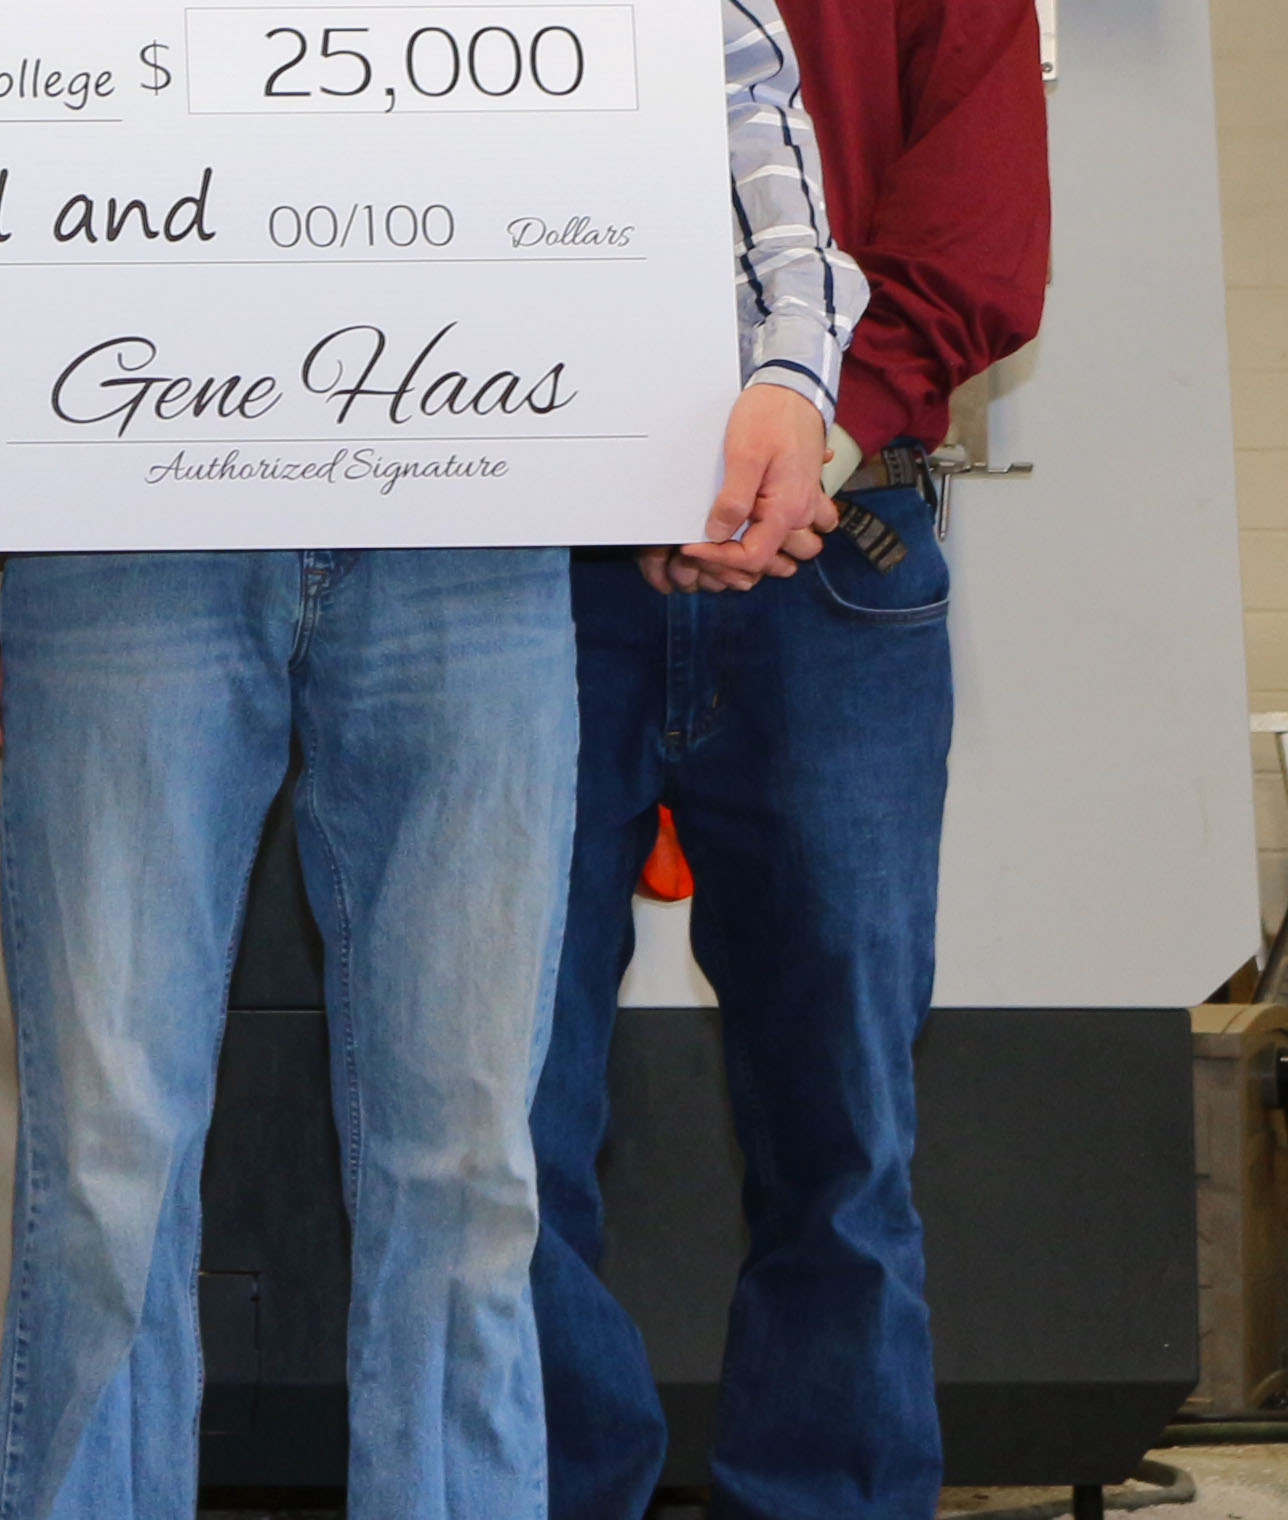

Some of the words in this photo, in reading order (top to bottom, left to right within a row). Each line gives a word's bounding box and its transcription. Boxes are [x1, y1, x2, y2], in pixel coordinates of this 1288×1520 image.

[139, 39, 173, 97] $
[262, 25, 585, 113] 25,000
[52, 166, 217, 245] and
[268, 203, 455, 249] 00/100
[506, 215, 635, 249] Dollars
[50, 335, 284, 438] Gene
[300, 320, 579, 425] Haas
[144, 449, 342, 484] Authorized
[344, 449, 509, 496] Signature
